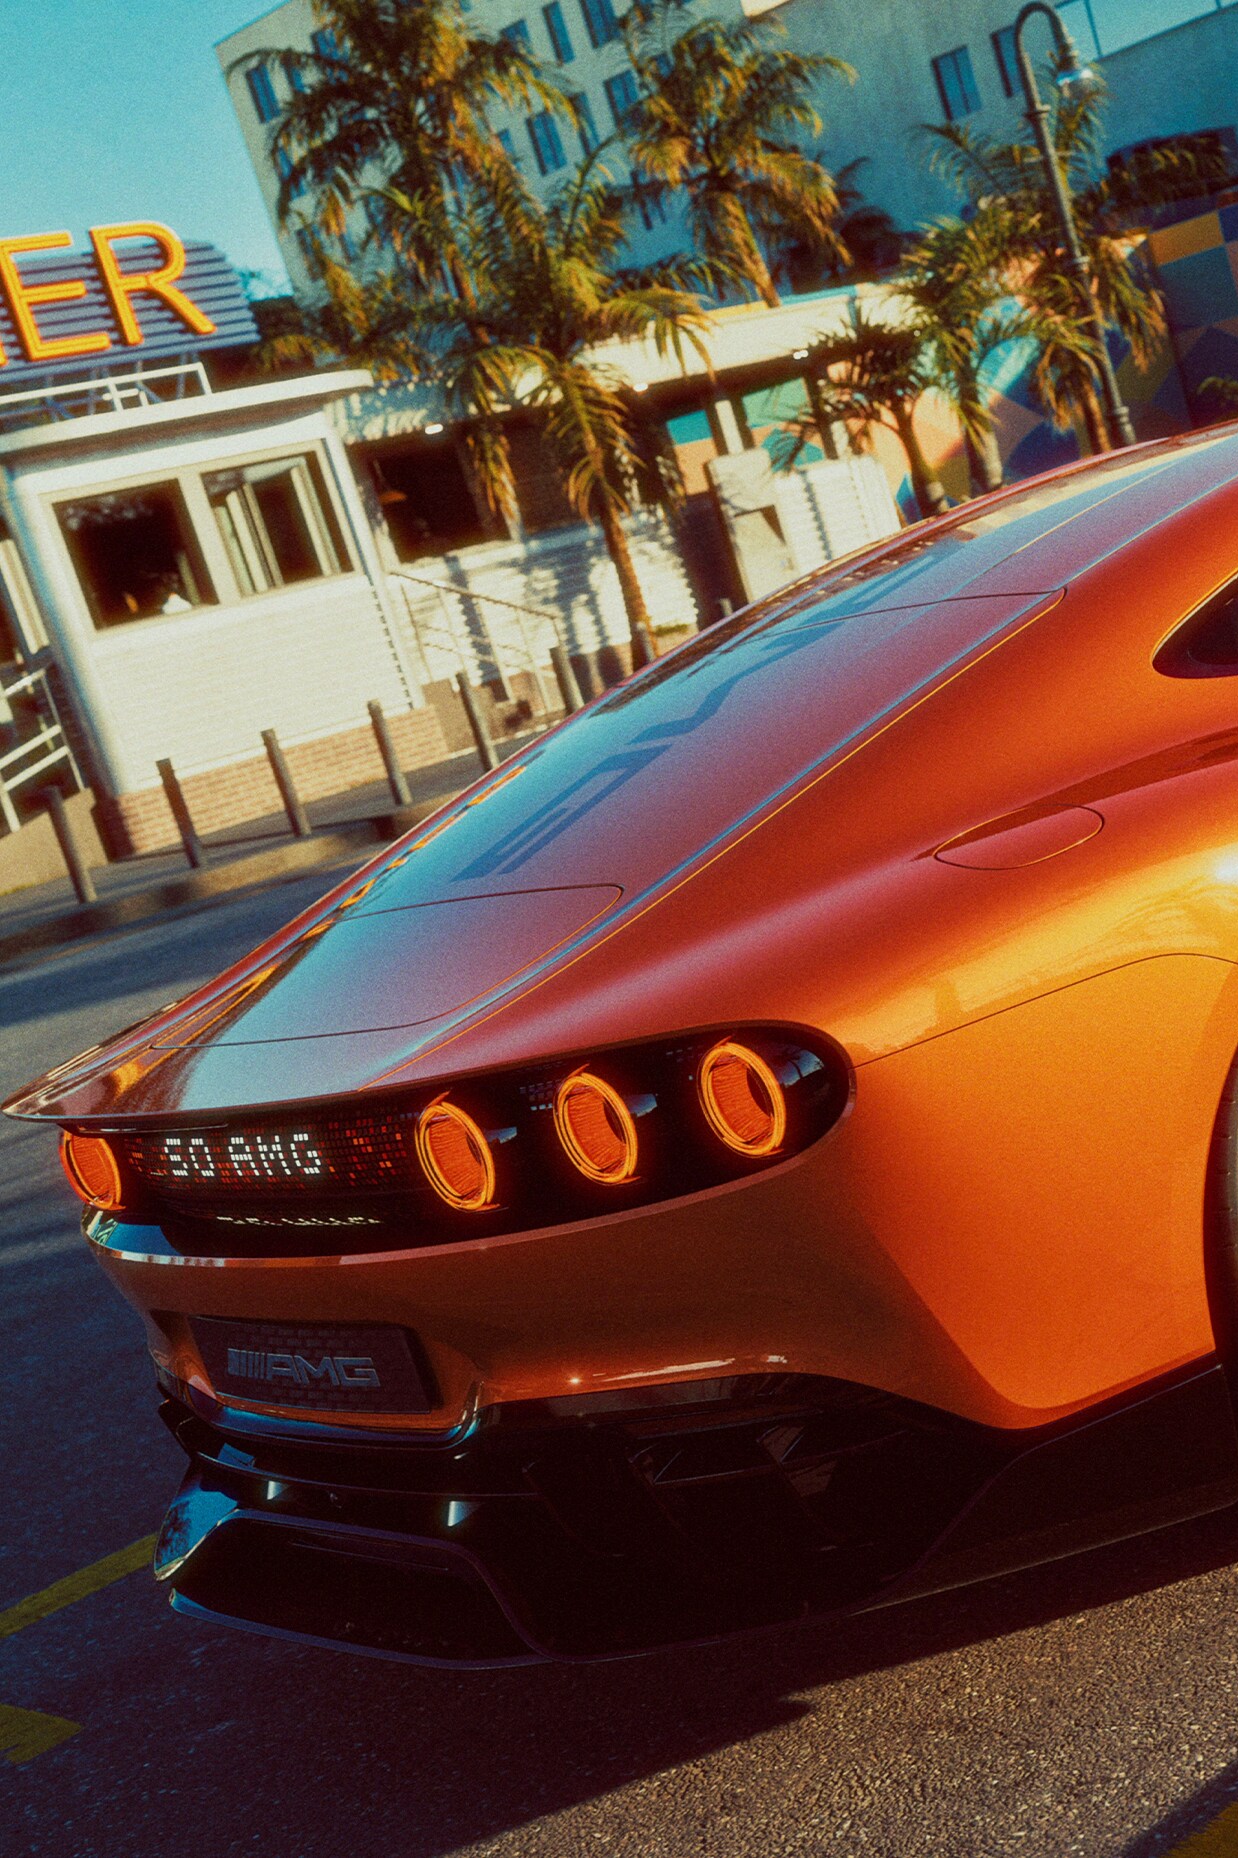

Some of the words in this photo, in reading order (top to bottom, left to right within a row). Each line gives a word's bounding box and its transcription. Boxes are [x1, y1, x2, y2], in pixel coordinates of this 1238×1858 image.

[0, 220, 217, 367] ER
[228, 1133, 321, 1177] AMG
[266, 1352, 381, 1388] AMG
